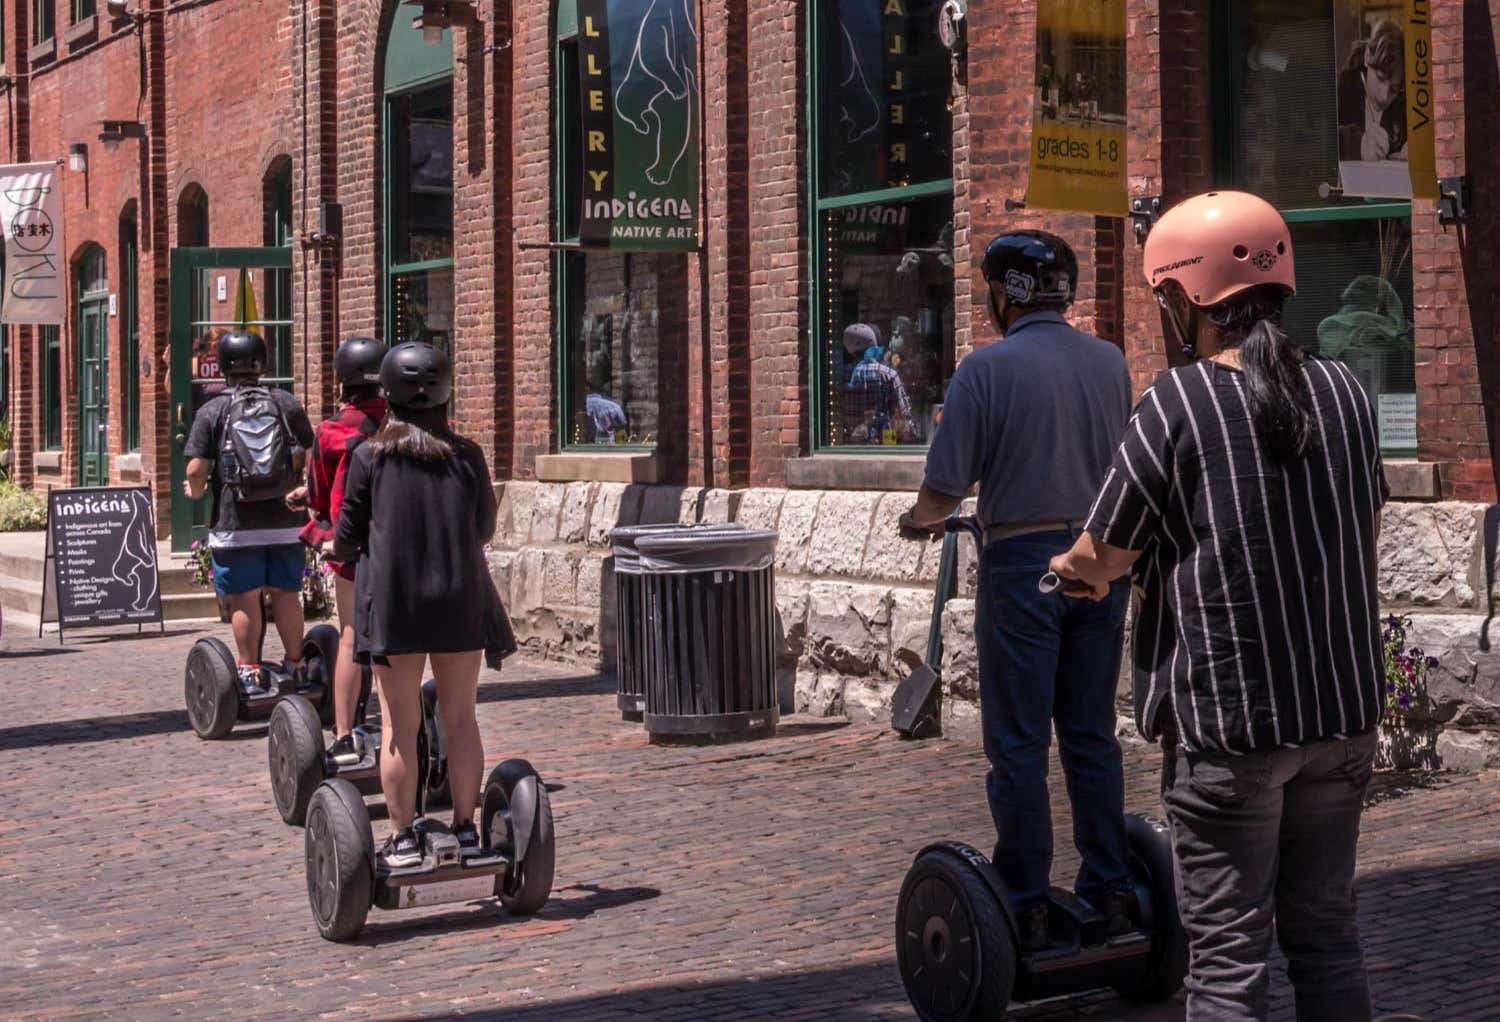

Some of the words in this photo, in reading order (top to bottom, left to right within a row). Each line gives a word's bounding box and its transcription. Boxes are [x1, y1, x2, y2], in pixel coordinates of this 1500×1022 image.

[1411, 39, 1430, 131] Voice
[1037, 136, 1090, 160] grades
[1095, 139, 1119, 162] 1-8
[612, 226, 663, 239] NATIVE
[66, 539, 96, 547] Sculptures
